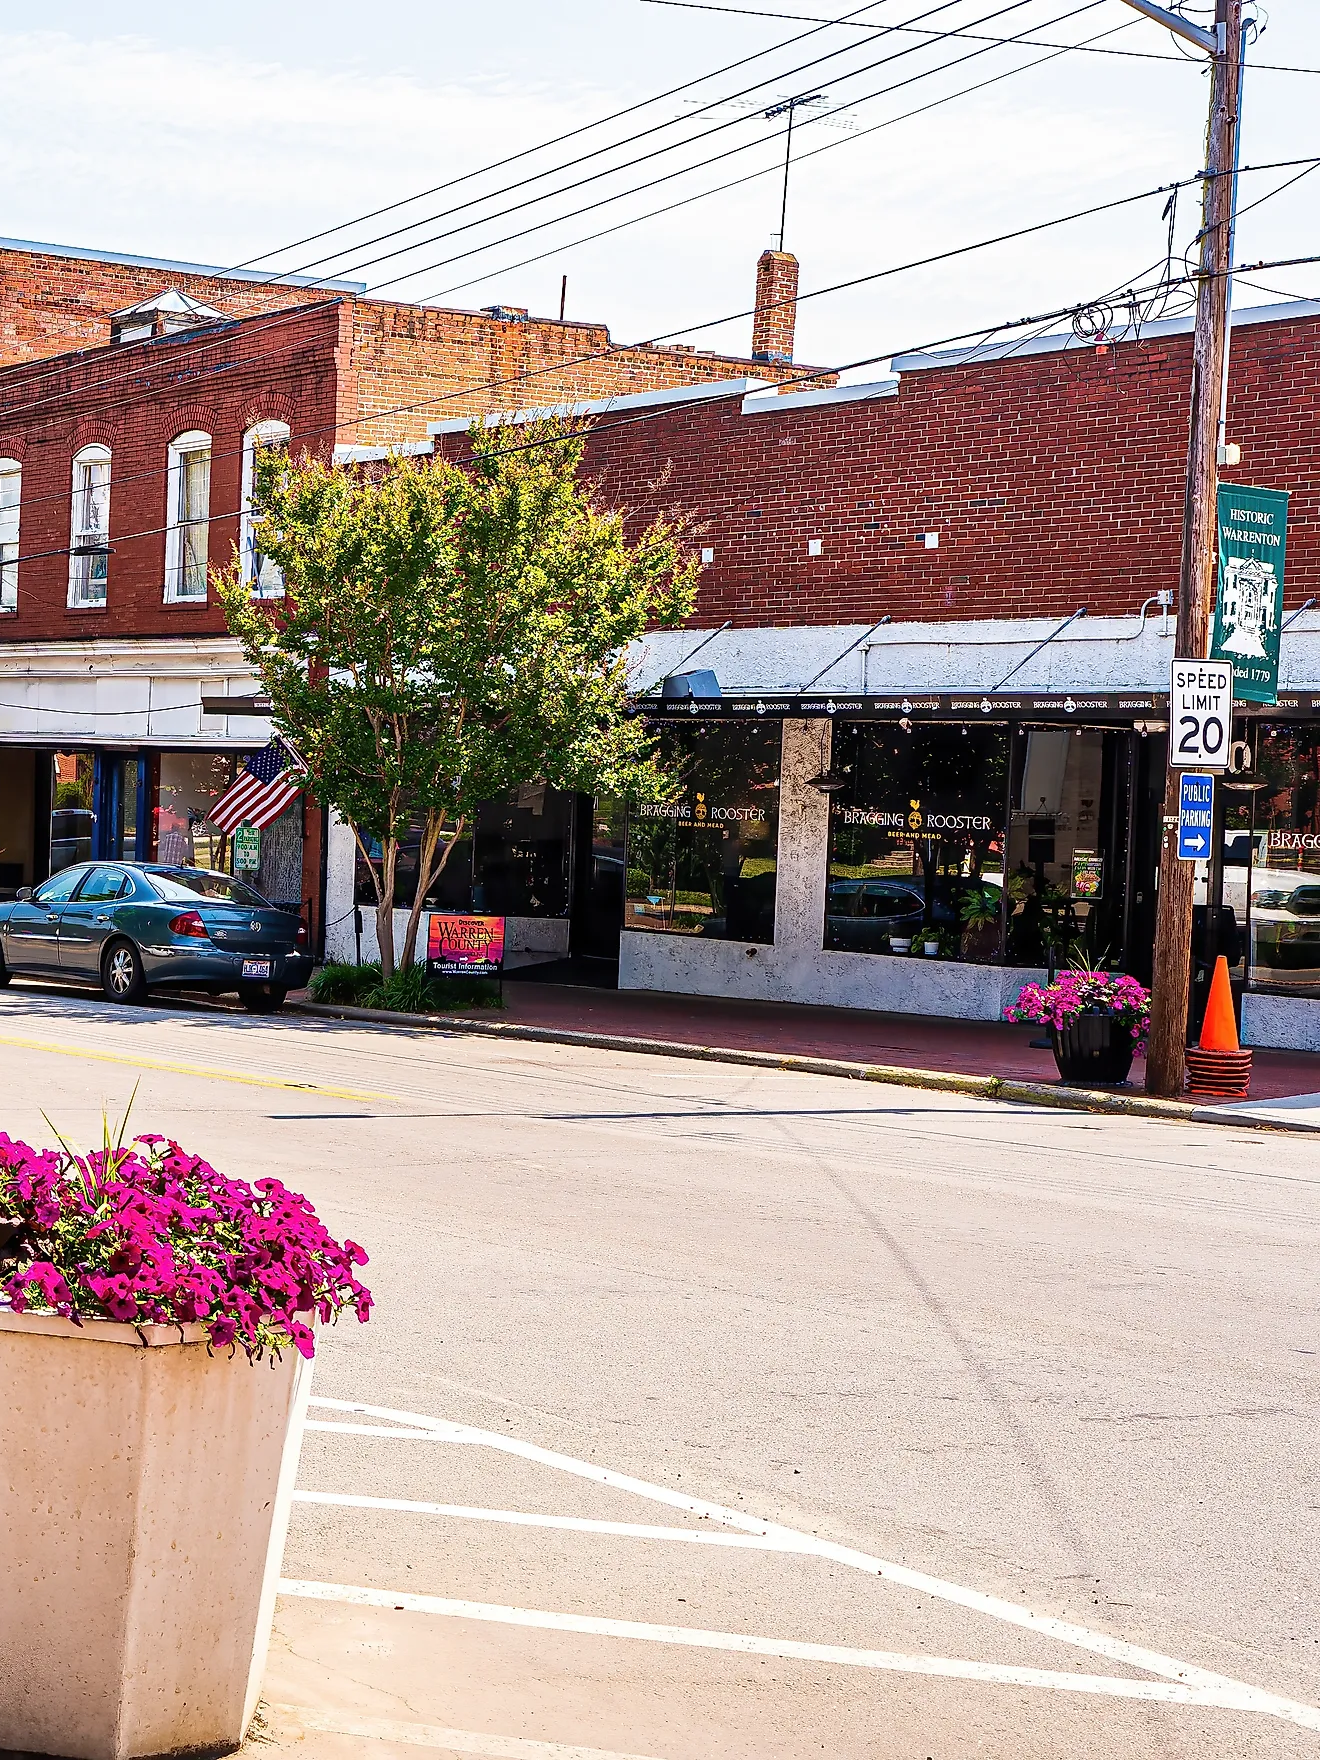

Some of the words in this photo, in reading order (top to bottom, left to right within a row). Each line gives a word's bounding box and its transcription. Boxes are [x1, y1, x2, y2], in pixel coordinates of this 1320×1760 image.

[1230, 508, 1274, 526] HISTORIC
[1222, 526, 1281, 547] WARRENTON
[1176, 672, 1227, 690] SPEED
[1251, 669, 1271, 682] 1779
[698, 703, 722, 711] ROOSTER
[765, 703, 791, 711] ROOSTER
[912, 702, 940, 710] ROOSTER
[991, 701, 1022, 709] ROOSTER
[1076, 700, 1108, 709] ROOSTER
[1118, 701, 1153, 709] BRAGGING
[1182, 693, 1221, 711] LIMIT
[1178, 715, 1224, 755] 20
[1183, 784, 1211, 803] PUBLIC
[640, 803, 692, 818] BRAGGING
[710, 806, 766, 821] ROOSTER
[1180, 809, 1211, 828] PARKING
[693, 821, 706, 829] AND
[708, 822, 725, 830] MEAD
[844, 810, 905, 827] BRAGGING
[927, 814, 991, 830] ROOSTER
[237, 830, 243, 842] 2
[887, 831, 905, 839] BEER
[905, 831, 921, 840] AND
[921, 832, 942, 840] MEAD
[437, 921, 495, 942] WARREN
[438, 936, 491, 958] COUNTY
[432, 961, 457, 970] Tourist
[458, 962, 498, 971] Information
